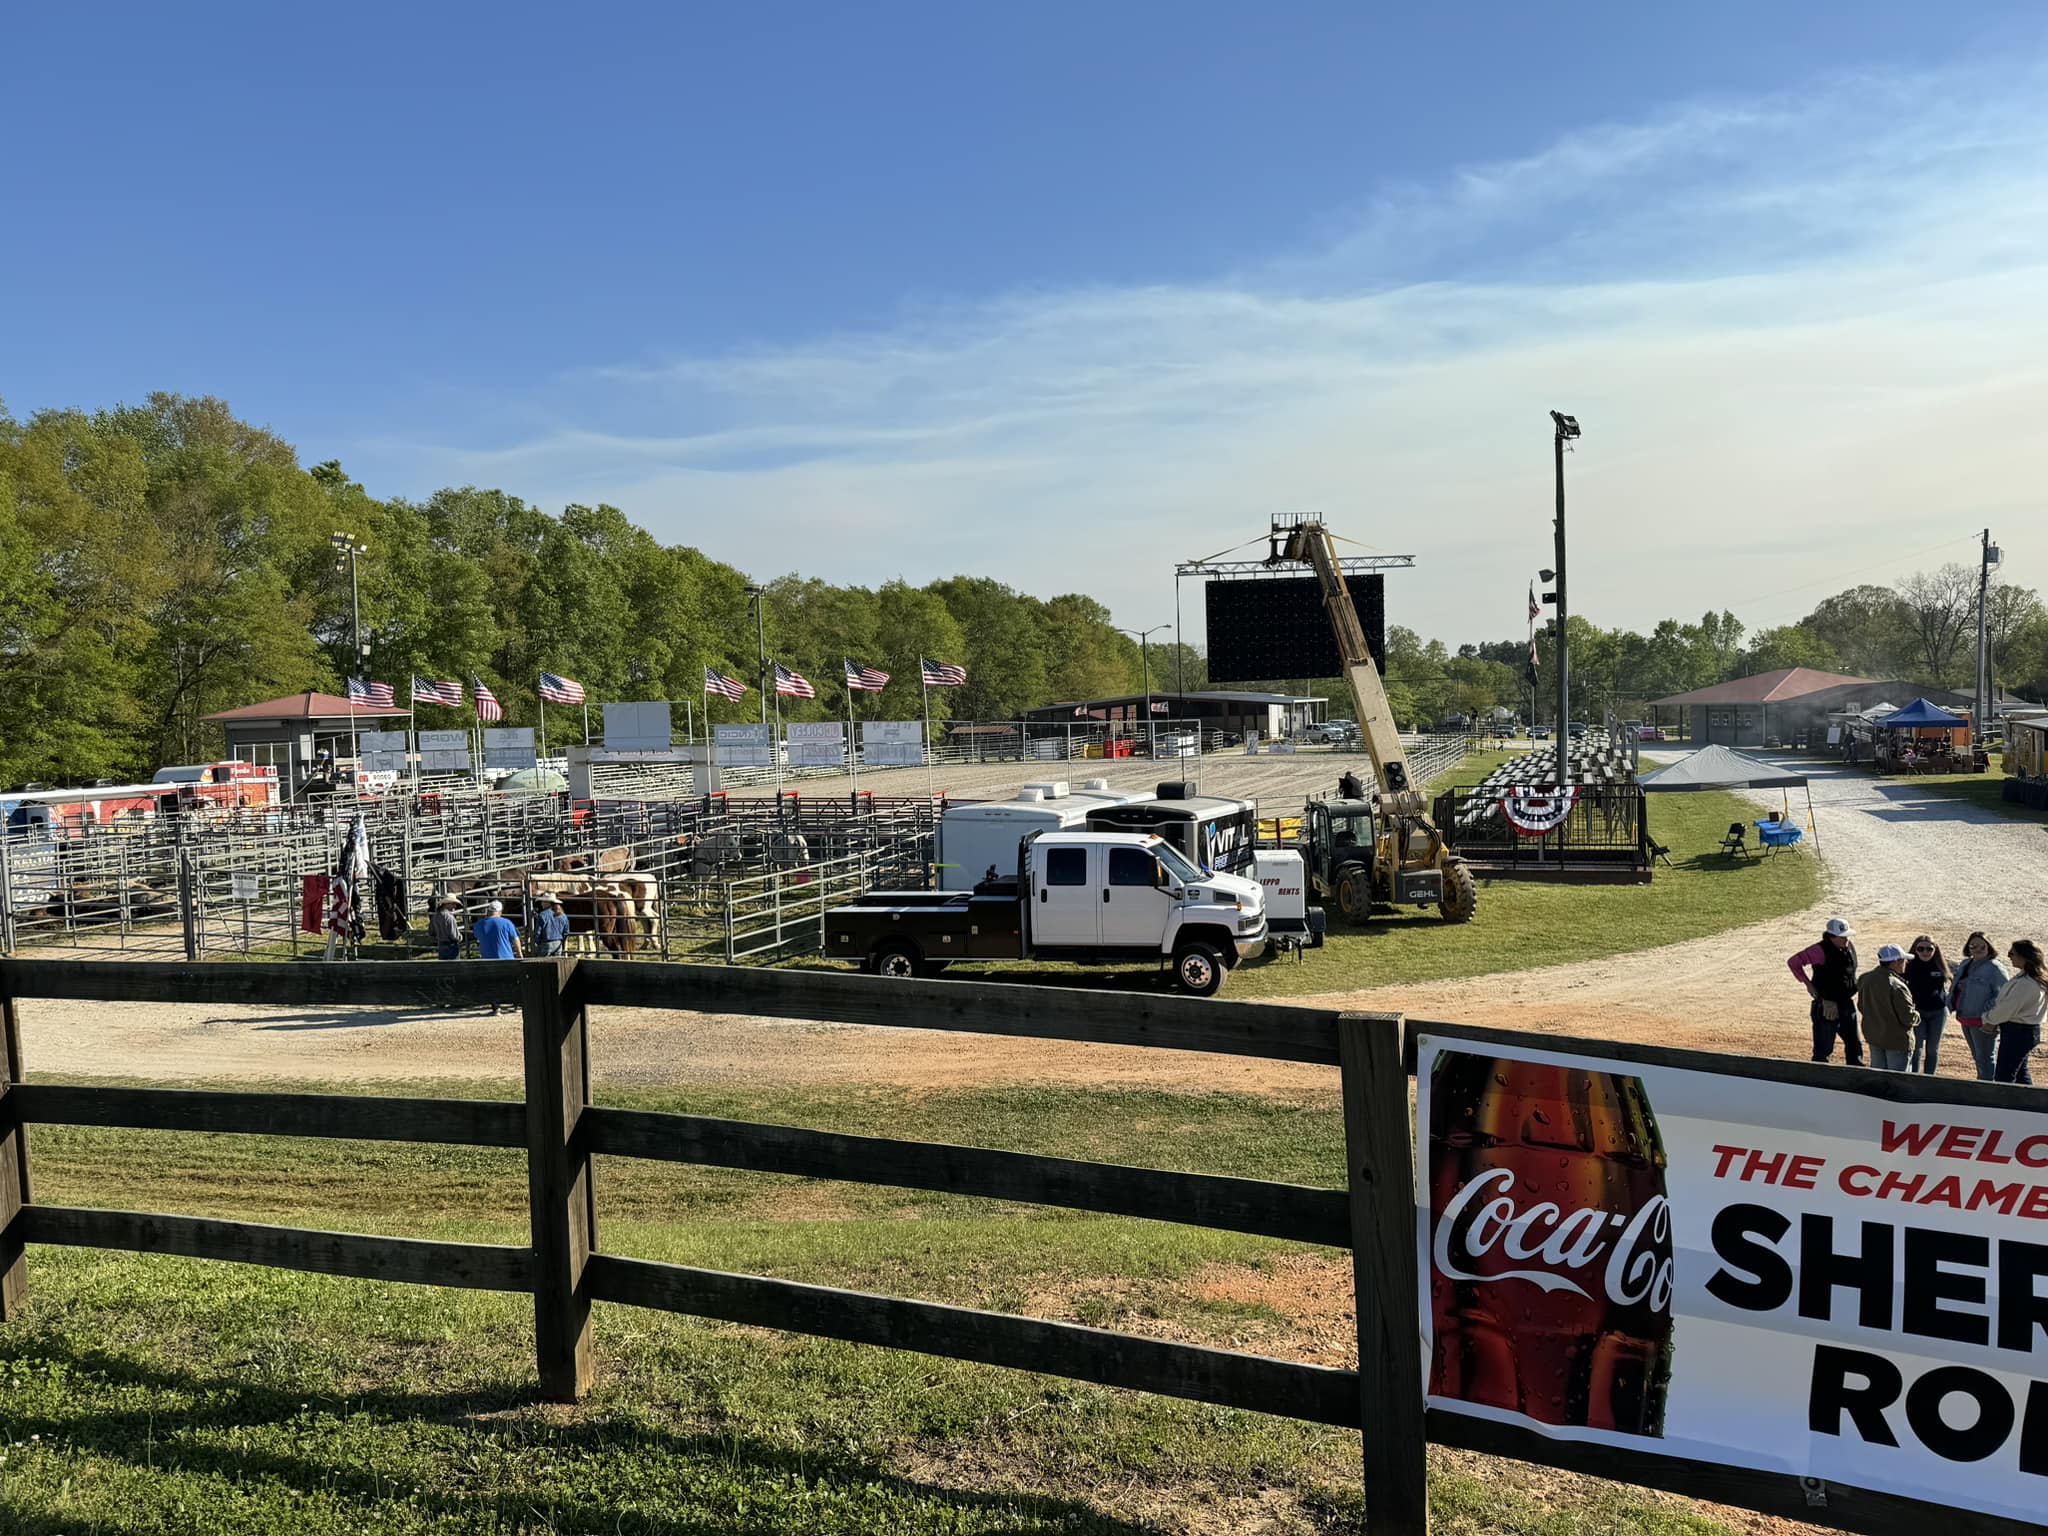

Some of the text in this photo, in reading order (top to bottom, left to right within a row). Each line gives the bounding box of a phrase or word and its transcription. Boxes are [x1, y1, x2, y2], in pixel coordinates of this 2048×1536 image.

[1278, 888, 1300, 896] RENTS
[1409, 890, 1438, 898] GEHL
[1881, 1119, 2048, 1168] WELC
[1712, 1144, 1825, 1189] THE
